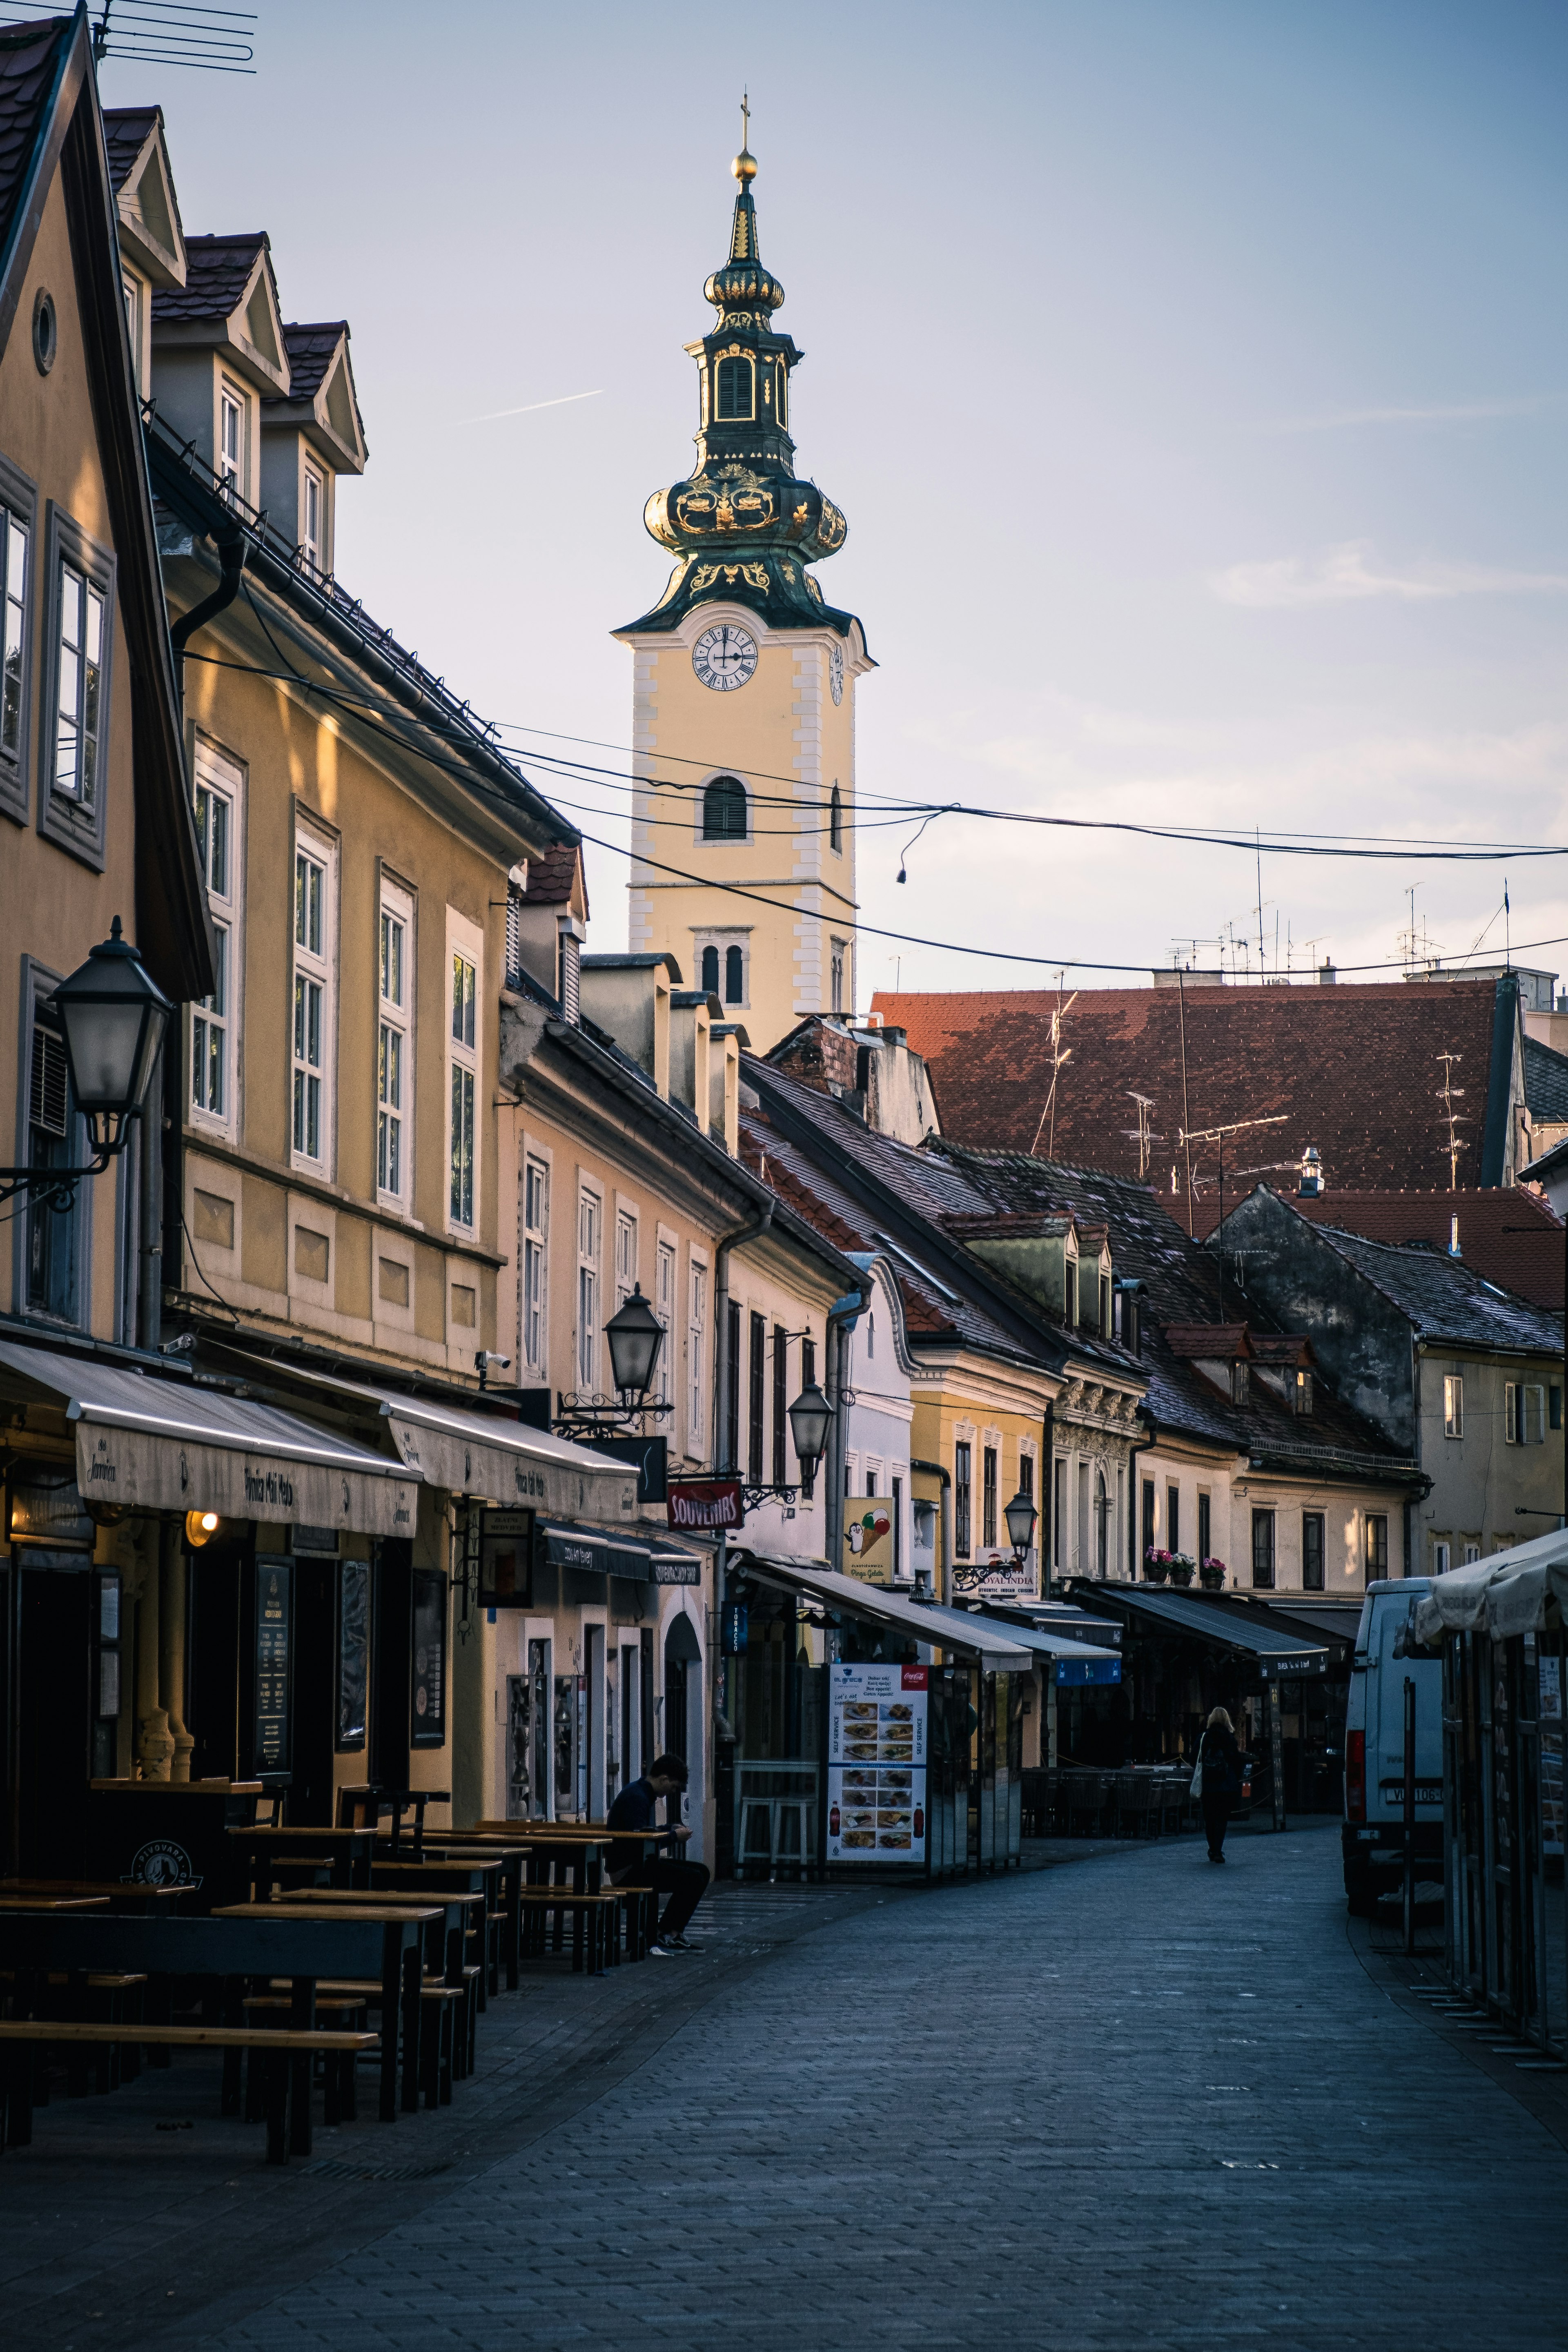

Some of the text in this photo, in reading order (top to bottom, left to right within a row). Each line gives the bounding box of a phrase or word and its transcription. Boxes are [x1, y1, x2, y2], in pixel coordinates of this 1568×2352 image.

[672, 1492, 737, 1526] SOUVENIRS
[1007, 1577, 1033, 1585] INDIA
[139, 1844, 184, 1862] PIVOVARA
